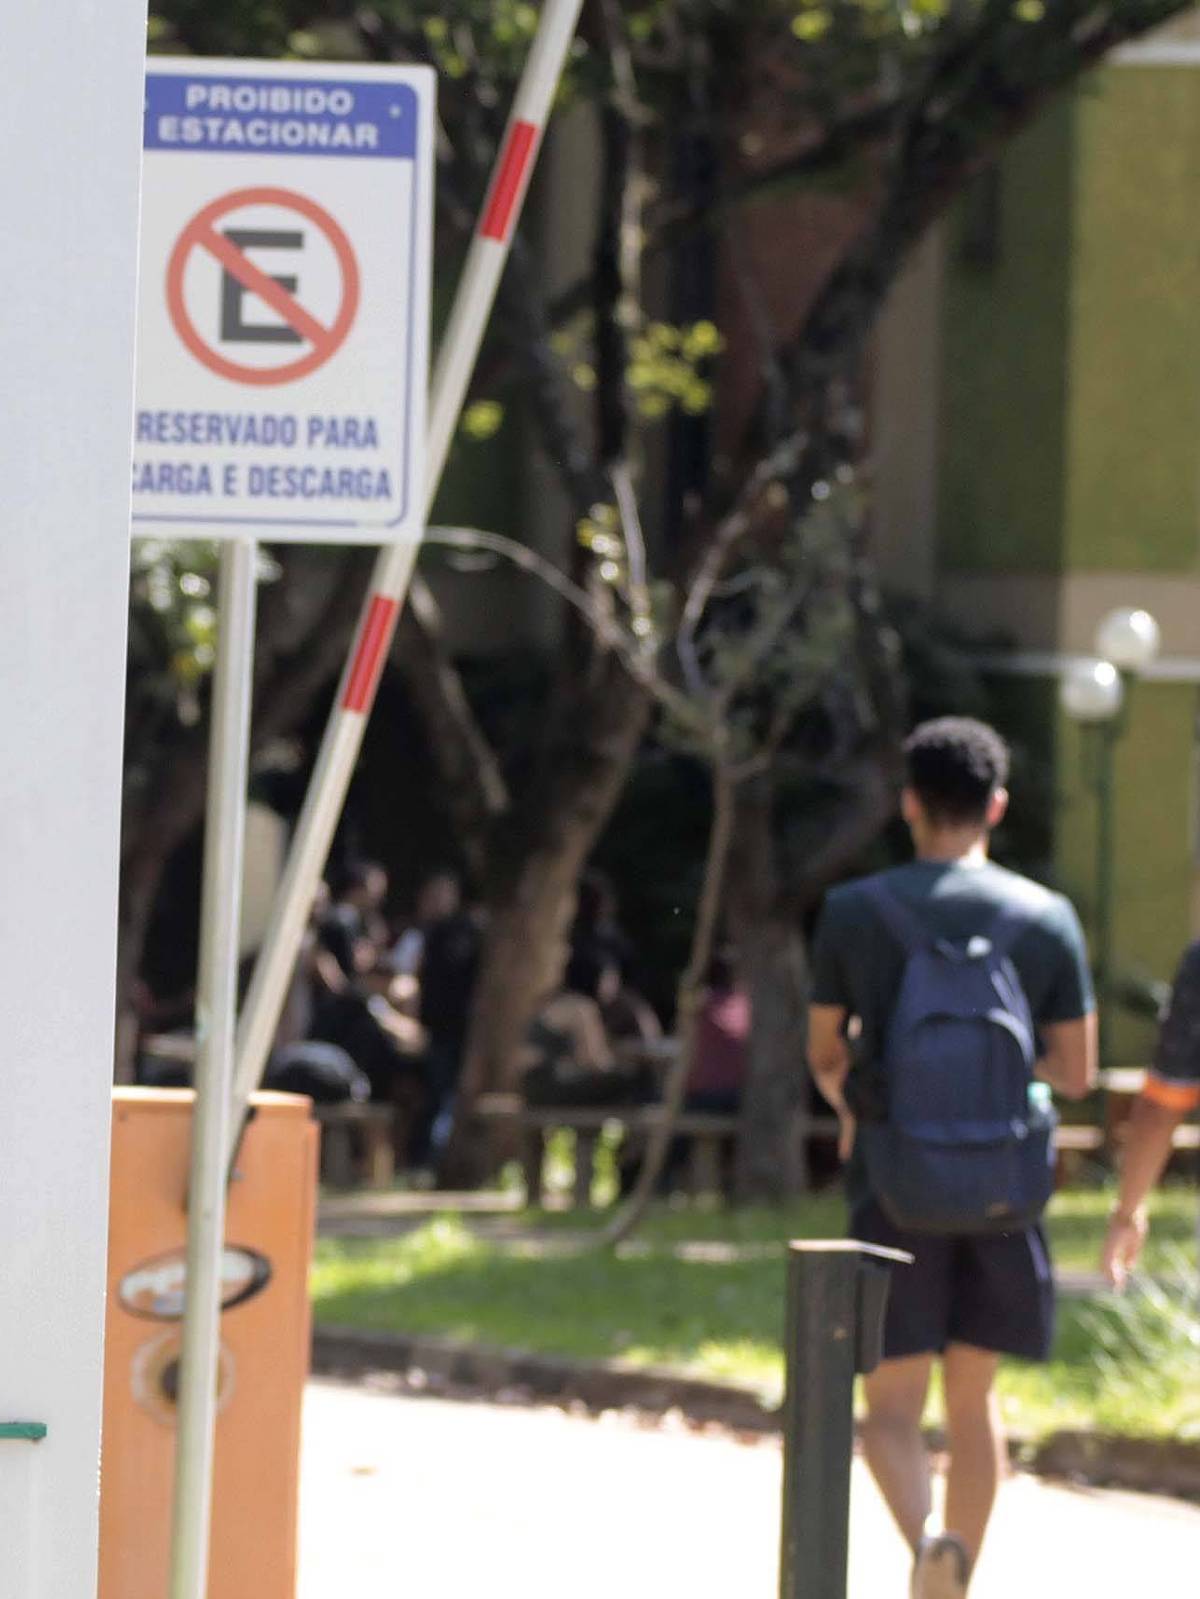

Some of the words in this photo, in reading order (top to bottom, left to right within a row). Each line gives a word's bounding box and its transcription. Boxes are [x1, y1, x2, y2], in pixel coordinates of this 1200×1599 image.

[185, 84, 354, 115] PROIBIDO
[158, 117, 379, 149] ESTACIONAR
[136, 410, 297, 447] RESERVADO
[307, 415, 379, 450] PARA
[223, 463, 238, 498] E
[248, 464, 393, 501] DESCARGA
